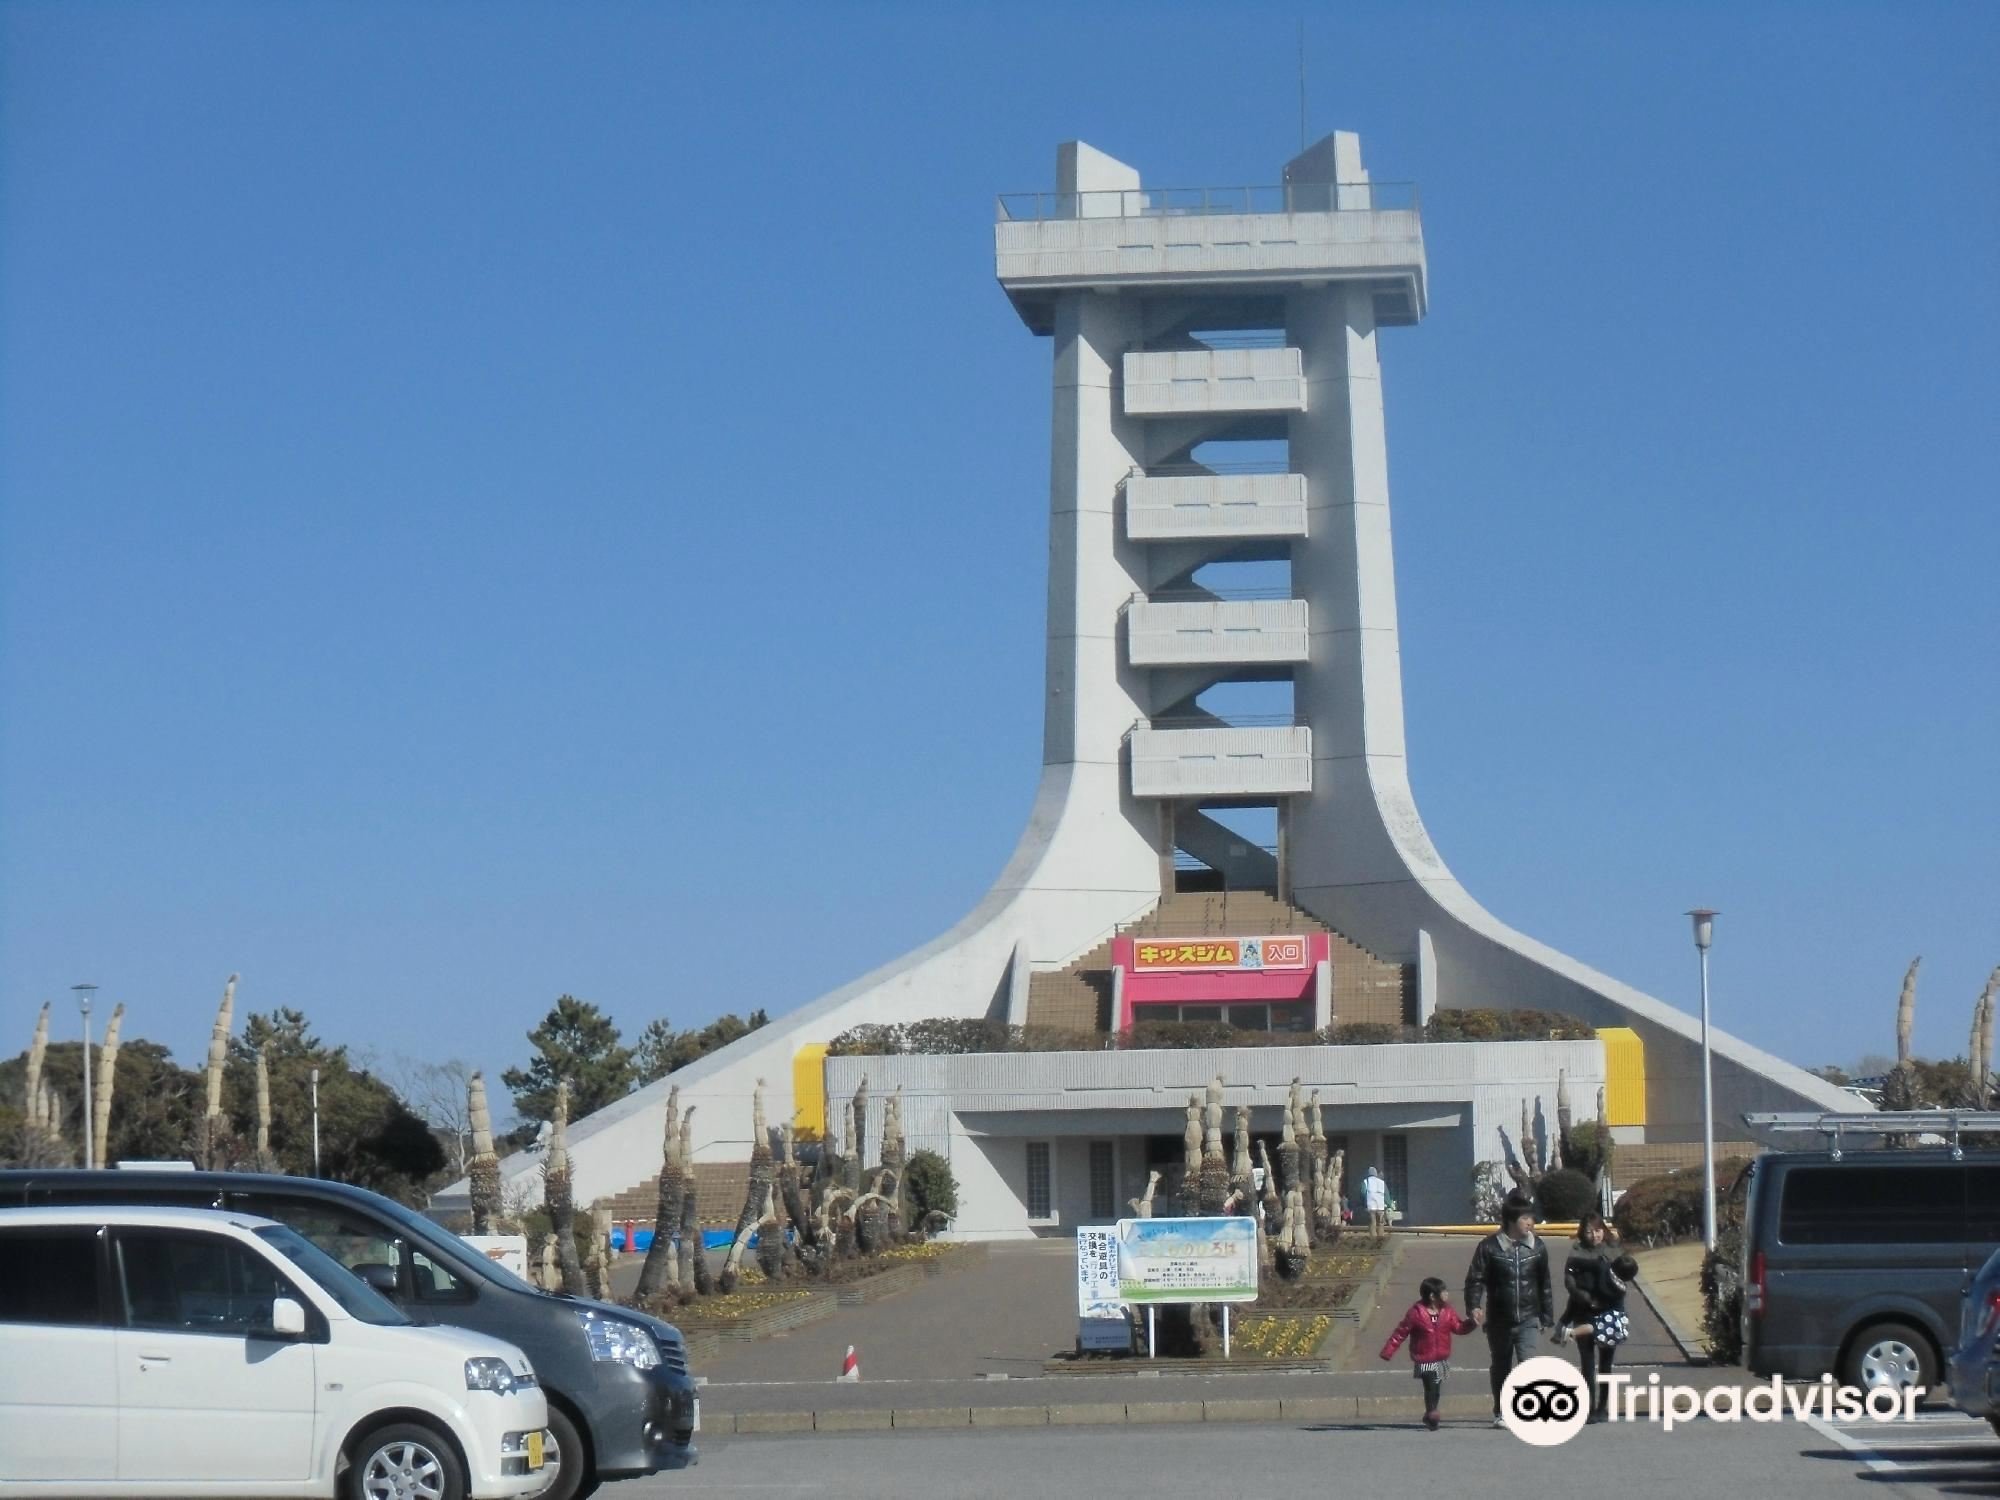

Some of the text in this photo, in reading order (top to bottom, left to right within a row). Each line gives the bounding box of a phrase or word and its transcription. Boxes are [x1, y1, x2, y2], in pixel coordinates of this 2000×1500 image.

[1140, 945, 1235, 963] キッズジム
[1268, 944, 1300, 961] 入口
[1097, 1232, 1108, 1280] 複合遊具の
